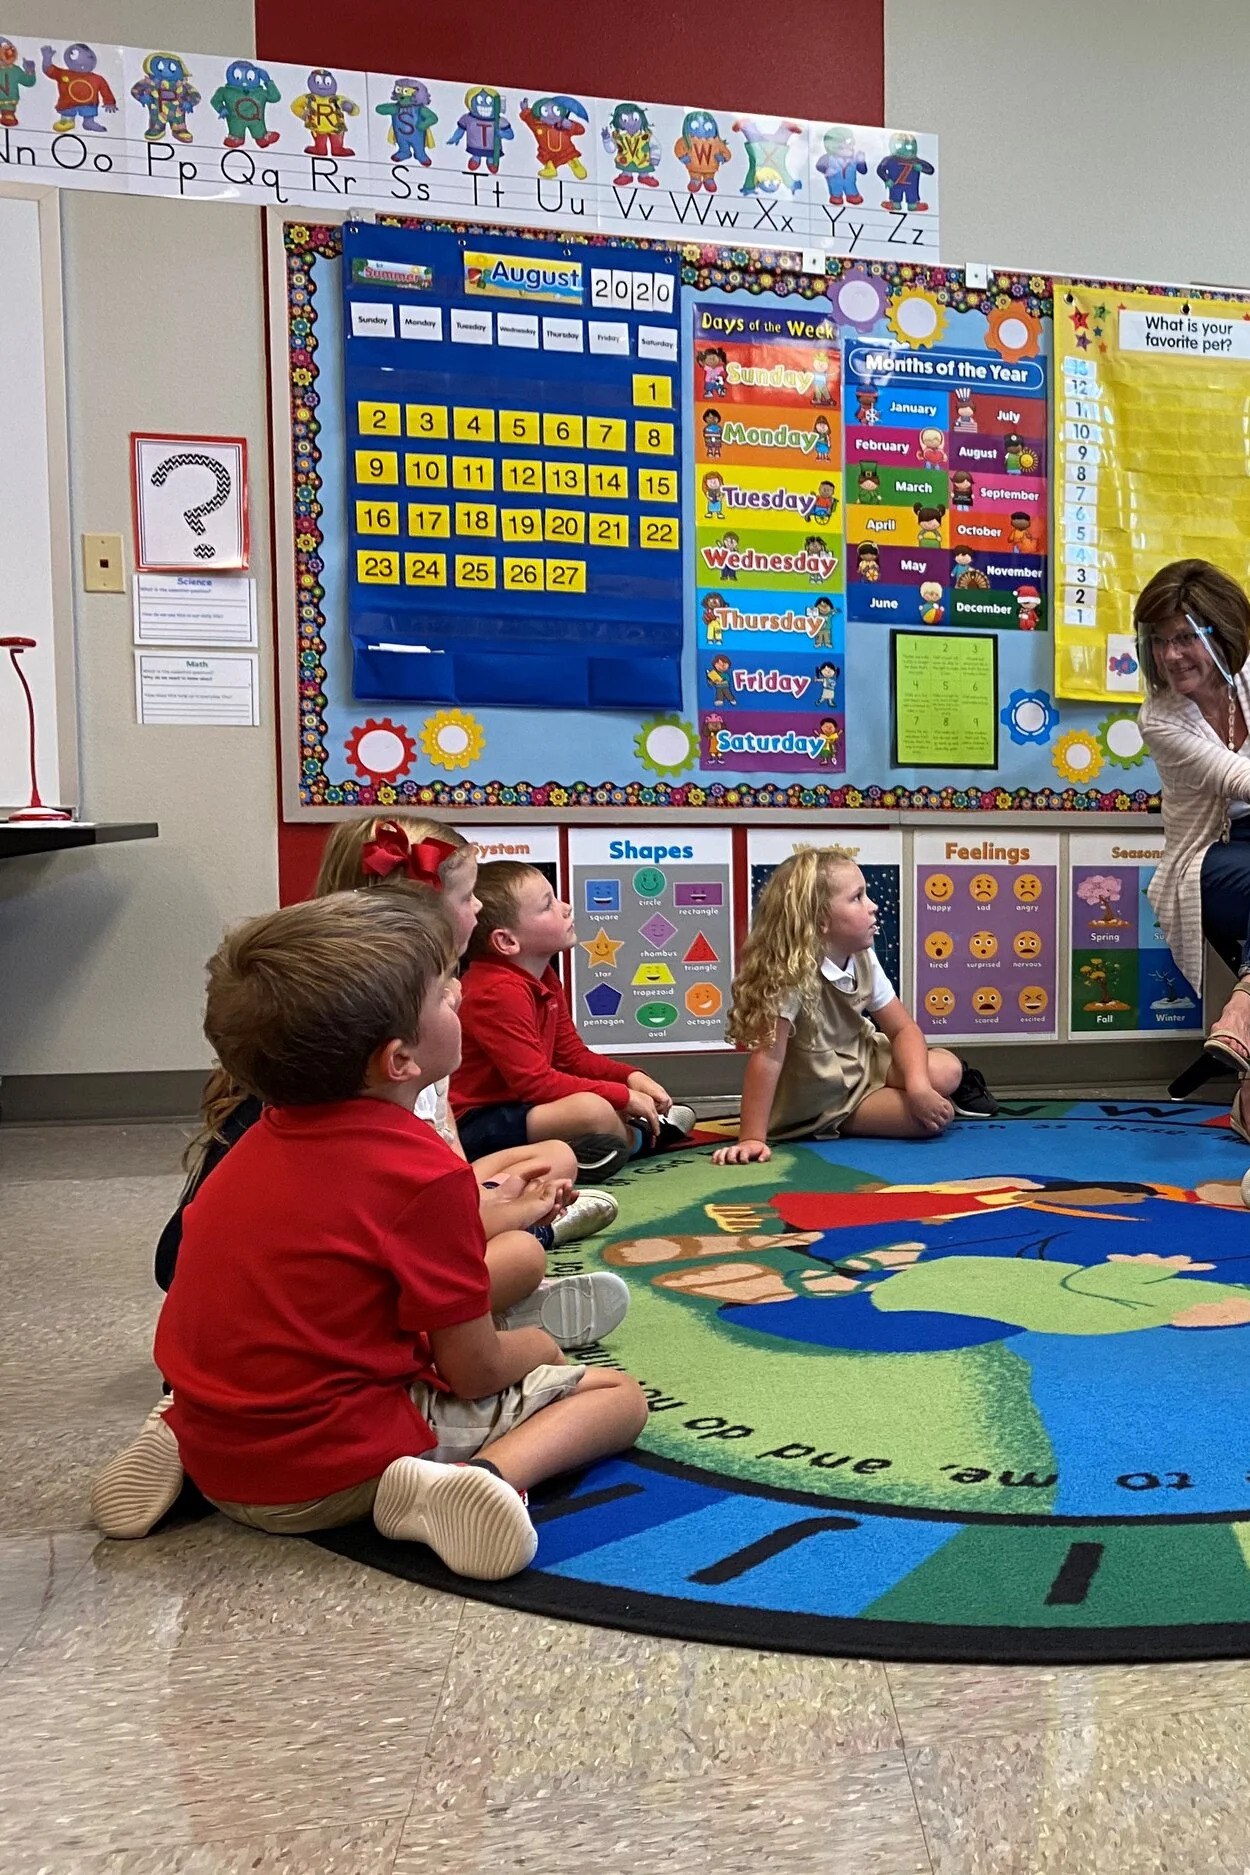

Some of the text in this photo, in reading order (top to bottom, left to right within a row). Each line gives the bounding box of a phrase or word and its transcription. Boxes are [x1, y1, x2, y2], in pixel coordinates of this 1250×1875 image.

[490, 260, 580, 291] August
[358, 315, 388, 328] Sunday
[404, 317, 437, 329] Monday
[456, 322, 487, 334] Tuesday
[701, 312, 835, 341] Days of the Week
[1145, 315, 1233, 339] What is your
[546, 330, 580, 342] Thursday
[641, 337, 674, 350] Saturday
[1145, 332, 1233, 353] favorite pet?
[865, 354, 1028, 383] Months of the Year
[726, 361, 815, 394] Sunday
[890, 402, 937, 417] January
[997, 410, 1020, 424] July
[372, 410, 387, 429] 2
[420, 412, 434, 431] 3
[513, 418, 527, 437] 5
[648, 429, 661, 447] 8
[722, 421, 819, 454] Monday
[855, 439, 910, 454] February
[958, 446, 997, 461] August
[369, 457, 384, 477] 9
[412, 461, 440, 480] 10
[509, 467, 536, 485] 12
[646, 476, 670, 495] 15
[895, 481, 933, 494] March
[721, 486, 817, 515] Tuesday
[980, 487, 1040, 502] September
[363, 508, 391, 528] 16
[508, 516, 535, 535] 19
[551, 517, 579, 536] 20
[646, 523, 673, 542] 22
[866, 519, 896, 533] April
[957, 524, 1002, 537] October
[364, 557, 393, 577] 23
[702, 548, 838, 579] Wednesday
[901, 559, 927, 574] May
[461, 562, 489, 581] 25
[552, 566, 580, 585] 27
[986, 565, 1042, 579] November
[177, 577, 212, 587] Science
[869, 597, 898, 610] June
[956, 602, 1012, 616] December
[714, 607, 826, 638] Thursday
[186, 660, 208, 669] Math
[733, 669, 811, 698] Friday
[716, 730, 827, 758] Saturday
[609, 840, 694, 863] Shapes
[945, 842, 1031, 864] Feelings
[638, 898, 661, 906] circle
[926, 903, 952, 913] happy
[976, 903, 991, 912] sad
[1016, 904, 1039, 913] angry
[589, 914, 619, 922] square
[679, 907, 719, 917] rectangle
[1090, 932, 1120, 943] Spring
[640, 949, 678, 958] rhombus
[684, 963, 718, 973] triangle
[929, 961, 949, 969] tired
[966, 961, 1001, 970] surprised
[594, 970, 612, 978] star
[633, 988, 674, 997] trapezoid
[583, 1018, 625, 1027] pentagon
[686, 1017, 721, 1027] octagon
[931, 1017, 947, 1026] sick
[974, 1016, 999, 1024] scared
[1020, 1015, 1046, 1024] excited
[1096, 1015, 1114, 1024] Fall
[1155, 1014, 1186, 1023] Winter
[648, 1030, 667, 1038] oval
[684, 1414, 755, 1442] do
[757, 1441, 893, 1476] and
[939, 1463, 1058, 1489] me,
[1115, 1471, 1194, 1491] to
[687, 1516, 862, 1585] J
[1043, 1542, 1105, 1606] I
